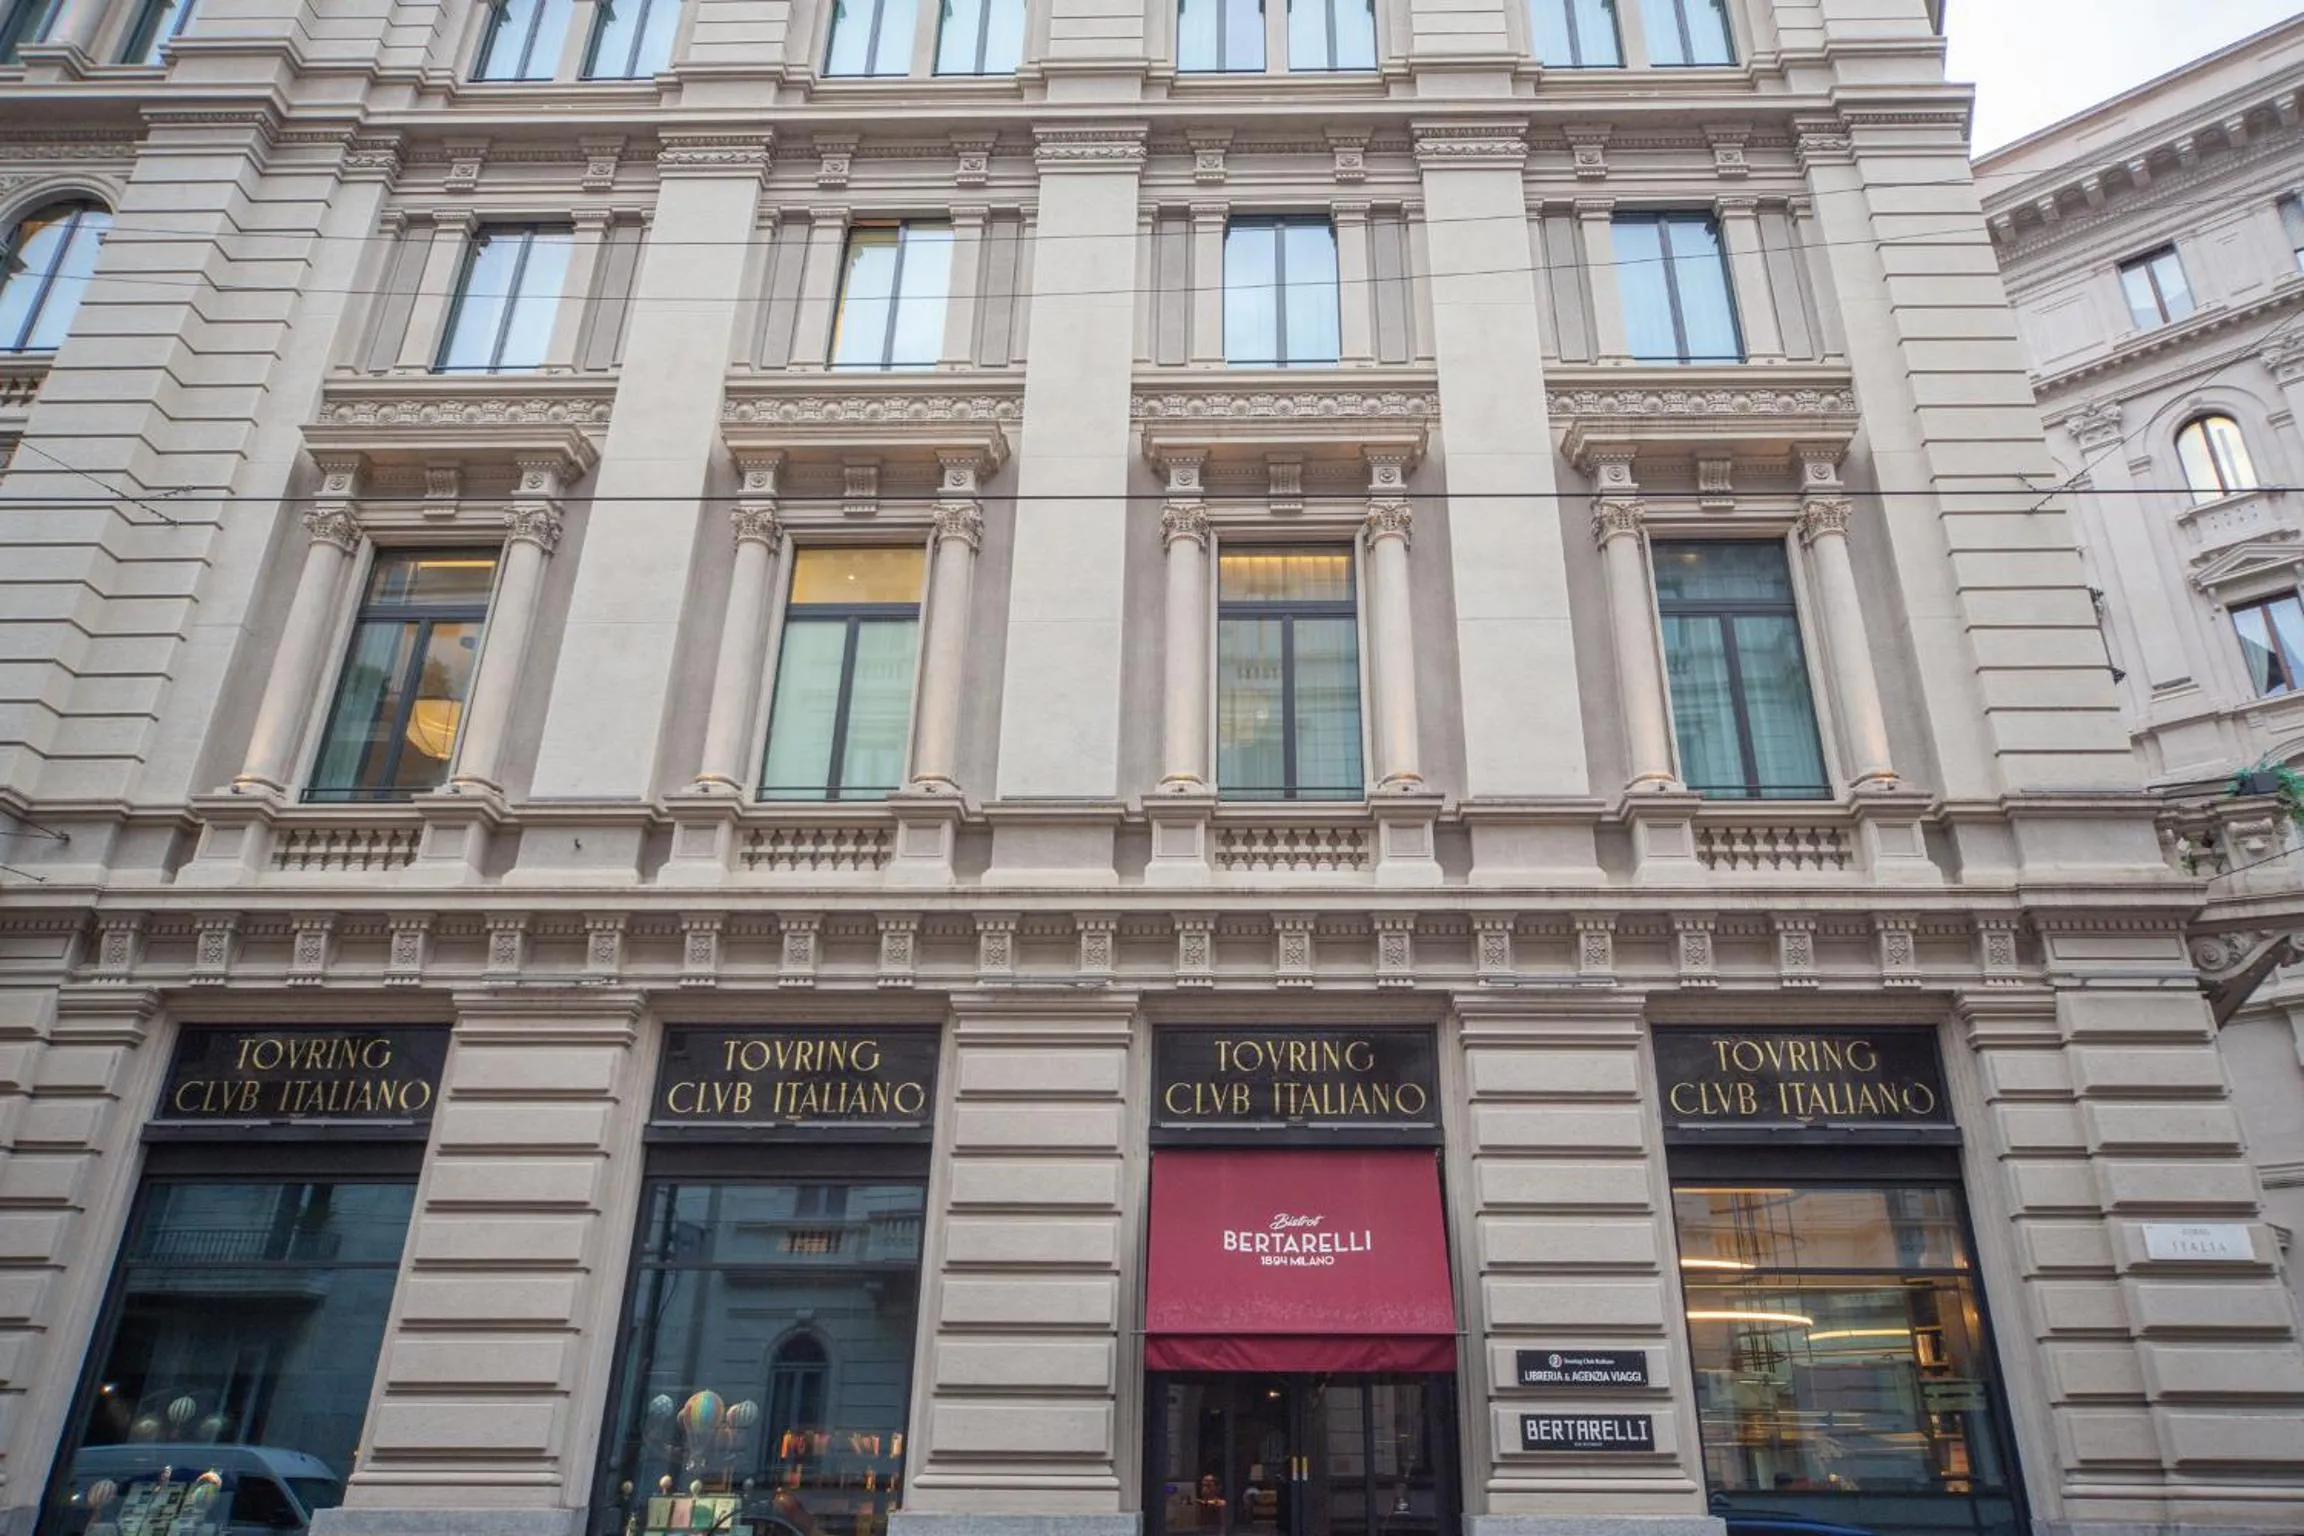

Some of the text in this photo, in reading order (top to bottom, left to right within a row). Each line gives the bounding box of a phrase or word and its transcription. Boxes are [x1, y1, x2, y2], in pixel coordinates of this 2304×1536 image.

[237, 1039, 393, 1070] TOVRING
[724, 1040, 880, 1071] TOVRING
[1214, 1040, 1375, 1072] TOVRING
[1712, 1040, 1878, 1072] TOVRING
[175, 1080, 432, 1112] CLVB ITALIANO
[667, 1082, 926, 1114] CLVB ITALIANO
[1165, 1082, 1427, 1115] CLVB ITALIANO
[1670, 1082, 1936, 1115] CLVB ITALIANO
[1268, 1213, 1325, 1230] Bistrot
[1223, 1230, 1372, 1253] BERTARELLI
[1260, 1255, 1335, 1267] 1894 MILANO
[1524, 1370, 1563, 1381] LIBRERIA
[1572, 1371, 1610, 1381] AGENZIA
[1610, 1371, 1642, 1382] VIAGGI
[1525, 1419, 1649, 1441] BERTARELLI
